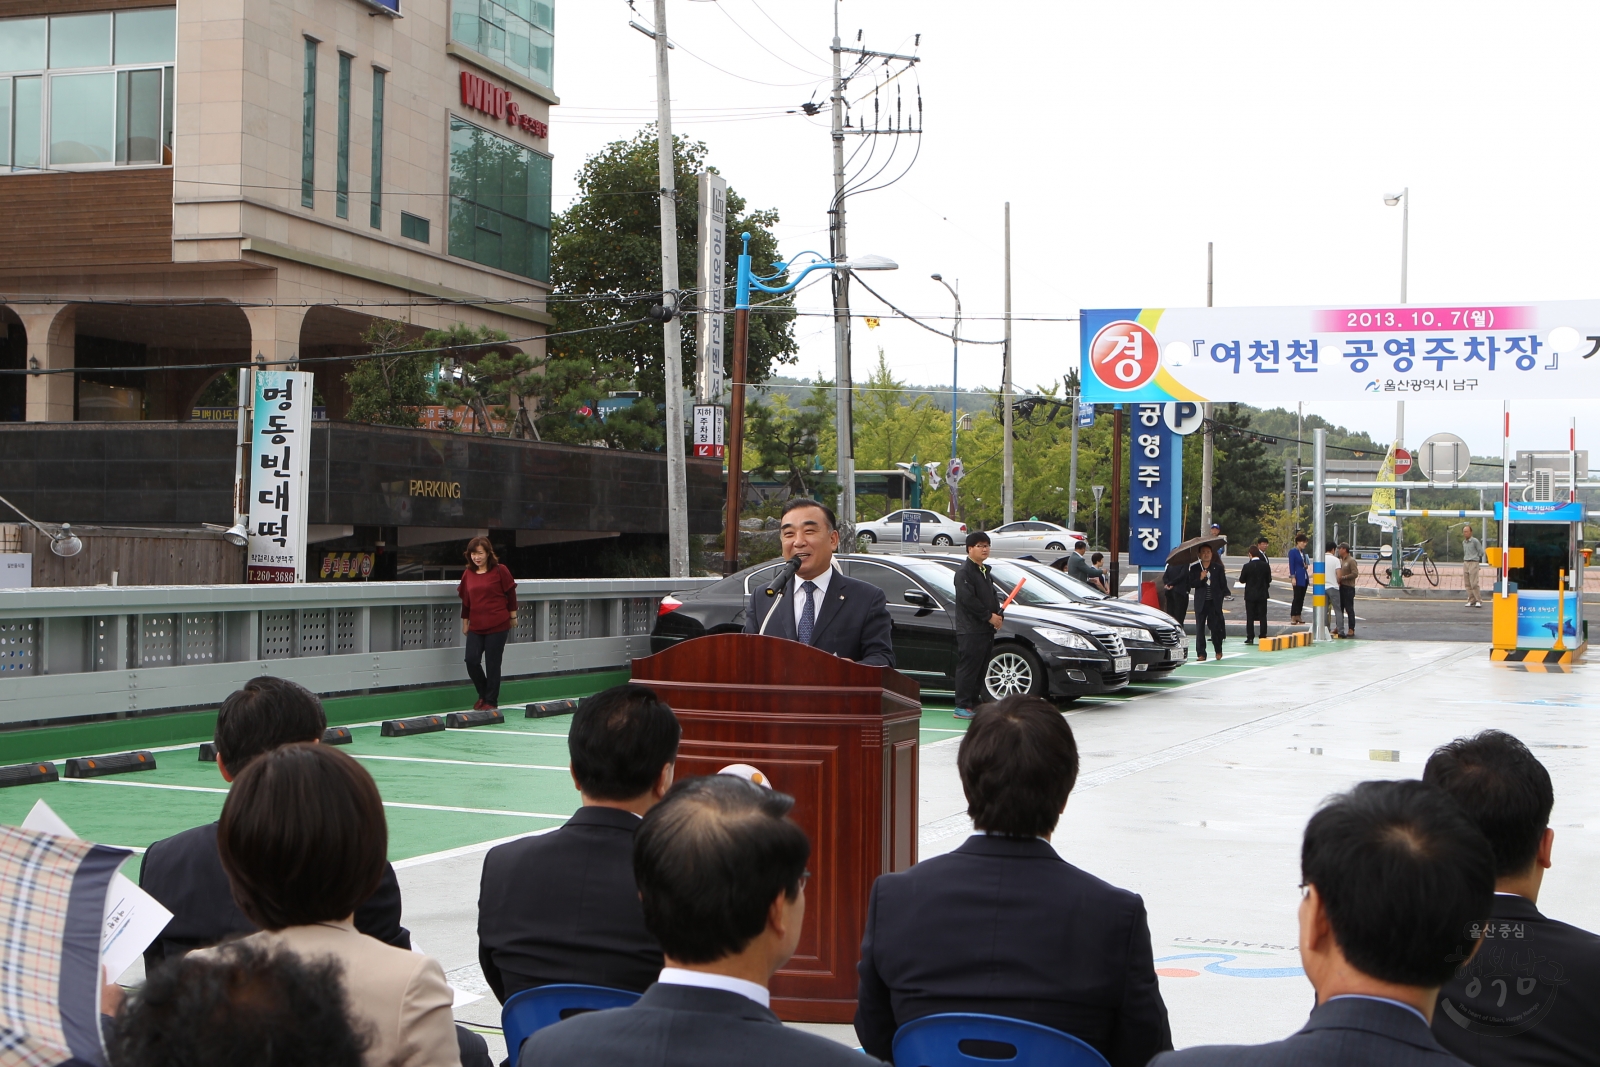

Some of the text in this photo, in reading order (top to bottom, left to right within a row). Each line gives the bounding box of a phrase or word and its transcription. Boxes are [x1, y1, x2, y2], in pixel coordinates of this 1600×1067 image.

[461, 71, 519, 126] WHO's
[1347, 309, 1495, 328] 2013. 10. 7(월)
[1101, 331, 1144, 383] 경
[1192, 339, 1319, 374] 『여천천
[1343, 335, 1559, 374] 공영주차장』
[1383, 377, 1479, 392] 울산광역시 남구
[697, 408, 712, 416] 지하
[1174, 402, 1197, 428] P
[699, 417, 709, 443] 주차장
[257, 378, 295, 548] 명동빈대떡
[1137, 403, 1162, 551] 공영주차장
[409, 479, 461, 499] PARKING
[904, 524, 911, 541] P
[248, 570, 295, 583] T.260-3686
[322, 557, 359, 575] 통과높이
